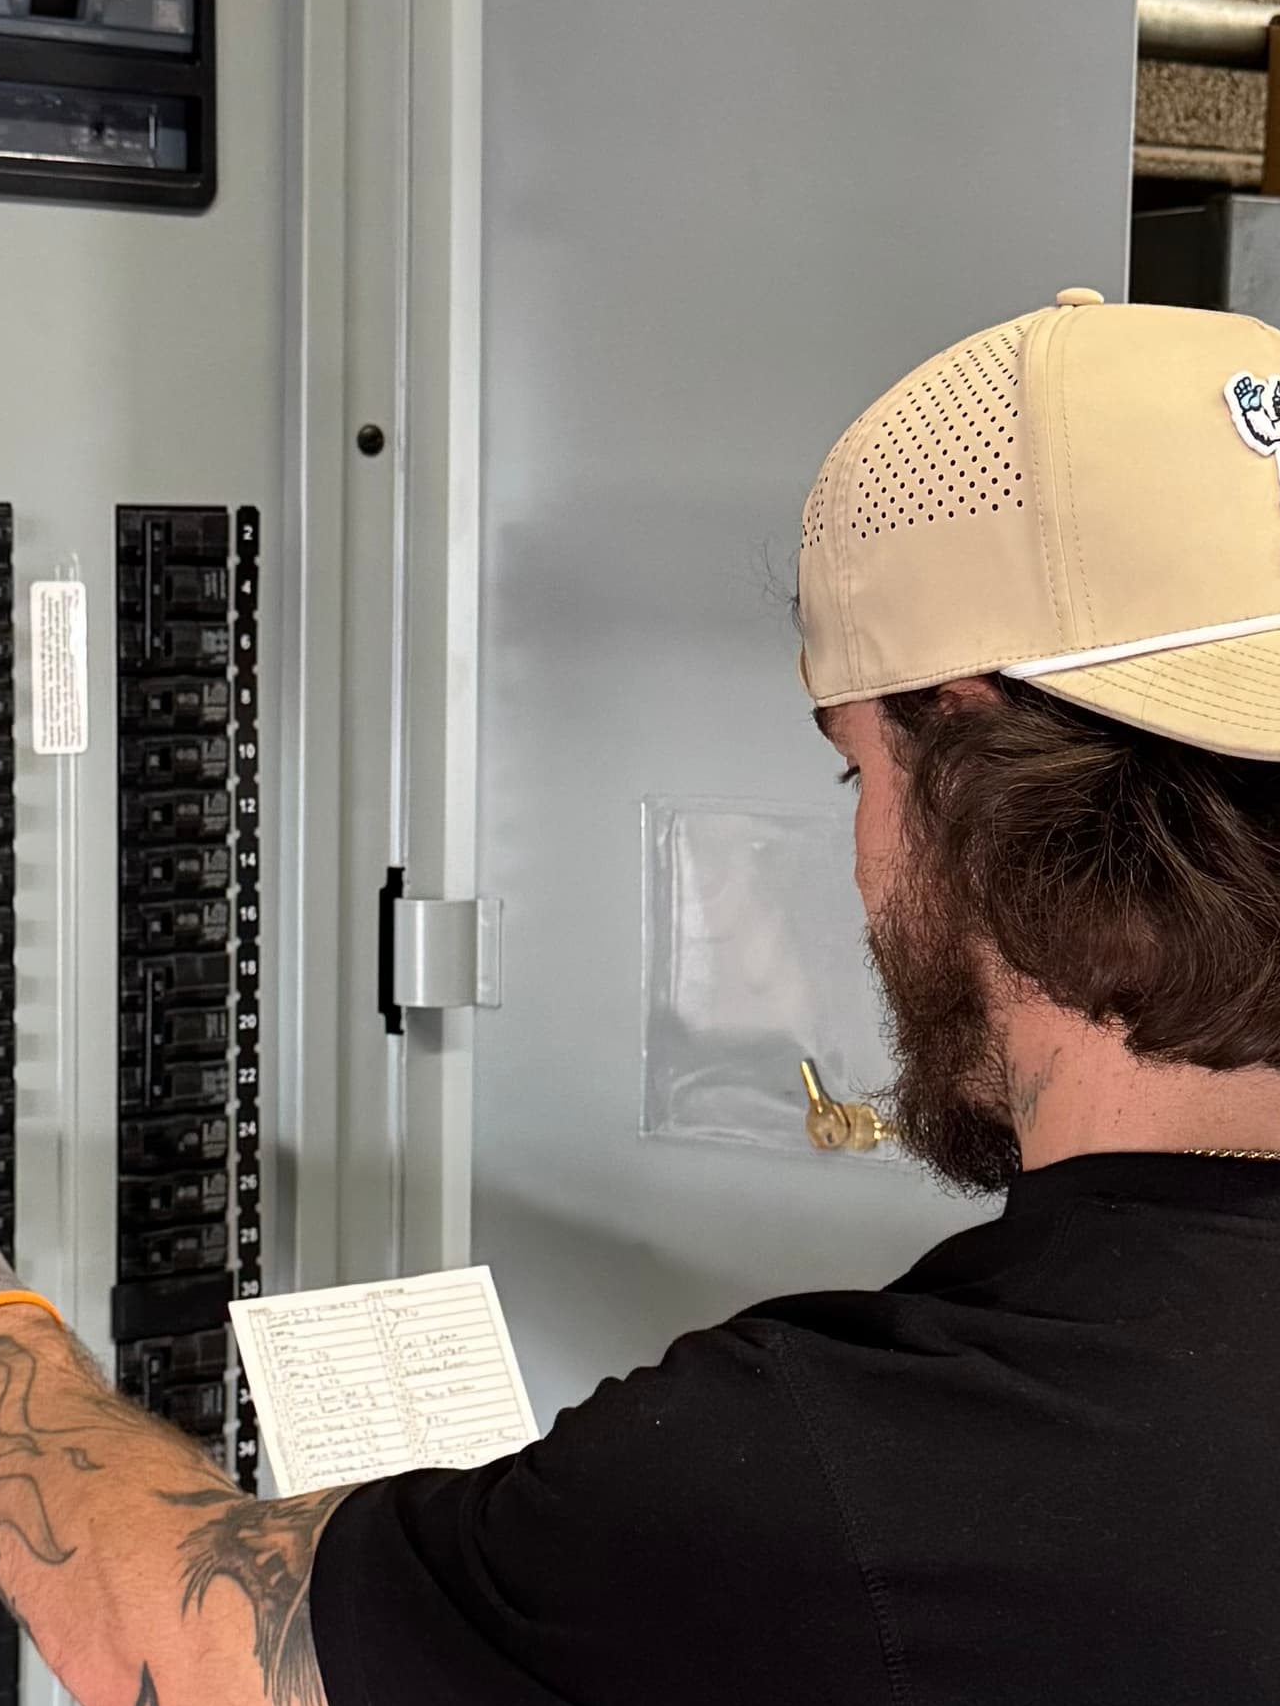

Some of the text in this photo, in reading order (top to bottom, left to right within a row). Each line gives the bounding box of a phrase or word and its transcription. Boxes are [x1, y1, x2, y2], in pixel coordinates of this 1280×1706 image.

[243, 524, 253, 541] 2
[241, 580, 252, 595] 4
[240, 634, 251, 651] 6
[240, 688, 251, 705] 8
[238, 742, 256, 760] 10
[239, 798, 256, 814] 12
[239, 852, 256, 869] 14
[239, 905, 257, 923] 16
[239, 959, 256, 976] 18
[238, 1014, 257, 1030] 20
[238, 1067, 257, 1084] 22
[238, 1121, 257, 1138] 24
[239, 1174, 258, 1191] 26
[240, 1227, 259, 1245] 28
[241, 1280, 259, 1297] 30
[239, 1388, 252, 1405] 3
[238, 1439, 257, 1458] 36
